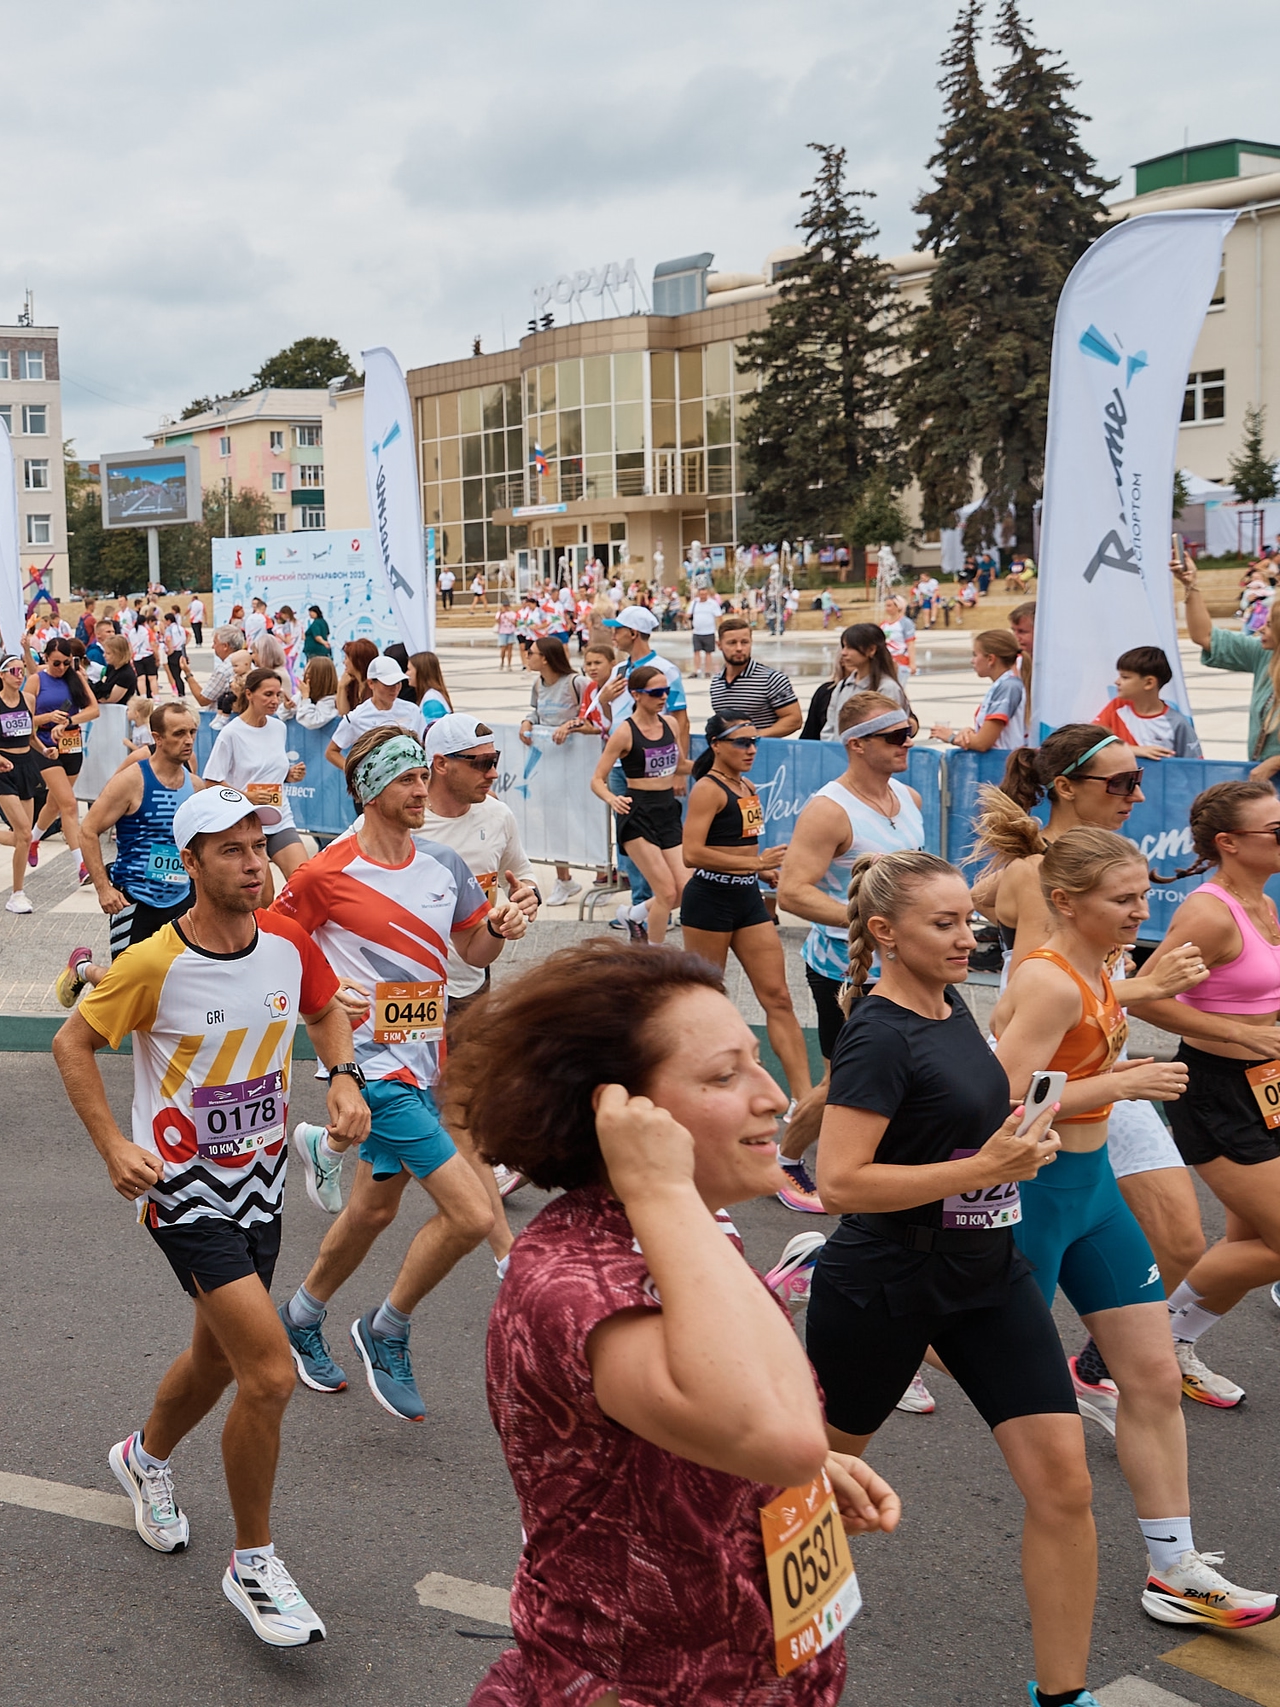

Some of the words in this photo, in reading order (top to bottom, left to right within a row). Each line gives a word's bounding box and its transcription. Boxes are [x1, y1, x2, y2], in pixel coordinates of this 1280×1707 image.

[255, 572, 296, 582] ГУБКИНСКИЙ
[297, 571, 348, 581] ПОЛУМАРАФОН
[349, 570, 366, 579] 2025
[5, 718, 28, 729] 0357
[731, 875, 755, 886] PRO
[206, 1009, 225, 1025] GRi
[384, 1001, 437, 1023] 0446
[383, 1032, 389, 1040] 5
[390, 1032, 401, 1040] KM
[207, 1097, 276, 1134] 0178
[208, 1145, 218, 1155] 10
[220, 1143, 234, 1154] KM
[955, 1214, 967, 1225] 10
[969, 1214, 986, 1225] KM
[783, 1511, 839, 1608] 0537
[790, 1637, 799, 1660] 5
[799, 1626, 816, 1656] KM
